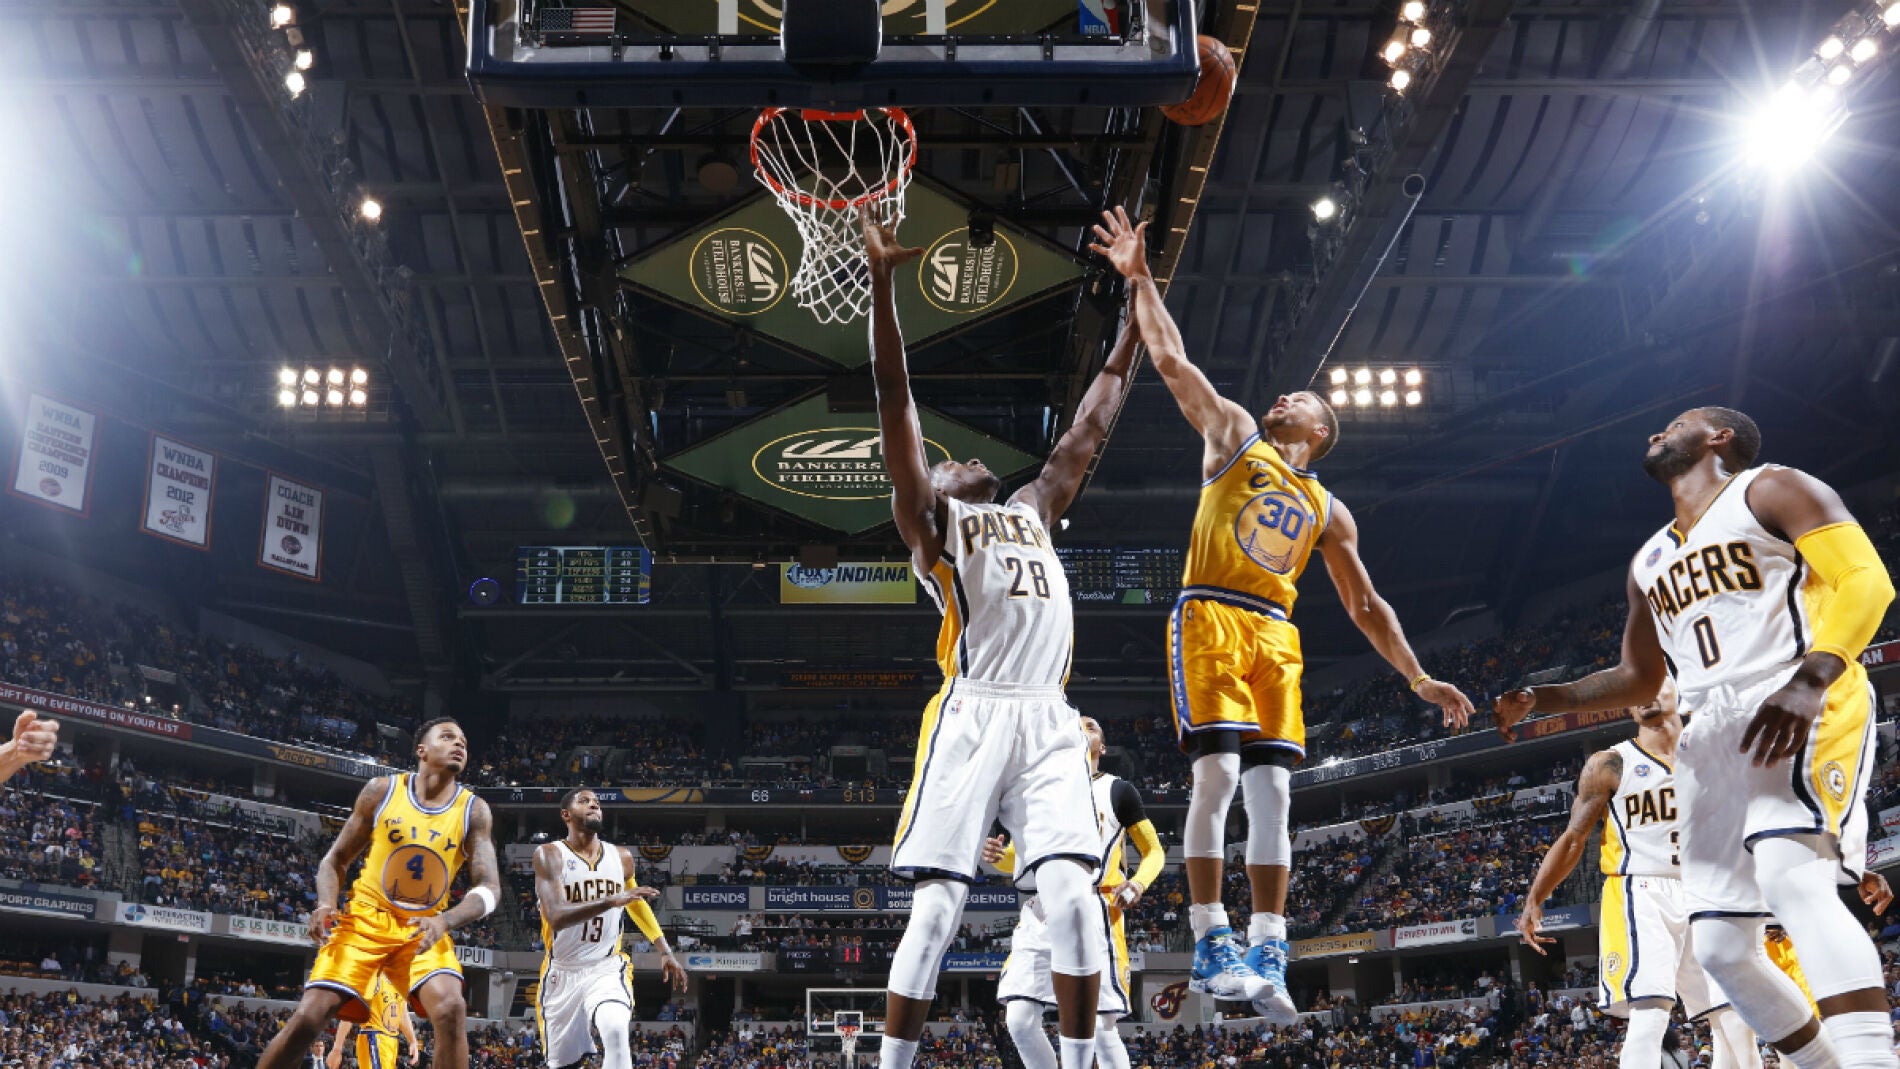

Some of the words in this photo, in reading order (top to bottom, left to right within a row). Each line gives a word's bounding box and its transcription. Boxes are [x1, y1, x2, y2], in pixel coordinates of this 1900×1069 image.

[1084, 25, 1106, 33] NBA
[41, 404, 82, 430] WNBA
[162, 446, 205, 472] WNBA
[777, 461, 881, 470] BANKERS
[778, 474, 893, 483] FIELDHOU
[167, 485, 195, 505] 2012
[277, 485, 315, 508] COACH
[284, 504, 305, 520] LIN
[1257, 497, 1304, 540] 30
[276, 515, 310, 536] DUNN
[836, 567, 908, 582] INDIANA
[1005, 557, 1050, 600] 28
[1647, 541, 1763, 638] PACERS
[1693, 615, 1721, 669] 0
[25, 693, 47, 706] FOR
[50, 699, 107, 719] EVERYONE
[109, 710, 124, 722] ON
[128, 715, 156, 728] YOUR
[157, 722, 179, 734] LIST
[843, 790, 875, 802] 9:13
[1624, 787, 1678, 830] PAC
[388, 826, 457, 851] CITY
[406, 854, 424, 881] 4
[684, 892, 747, 904] LEGENDS
[768, 890, 808, 904] bright
[810, 892, 850, 902] house
[887, 889, 914, 898] busin
[965, 893, 1016, 904] EGENDS
[34, 897, 94, 914] GRAPHICS
[887, 899, 913, 909] solut
[581, 916, 604, 943] 13
[1428, 926, 1439, 936] TO
[1440, 924, 1456, 936] WIN
